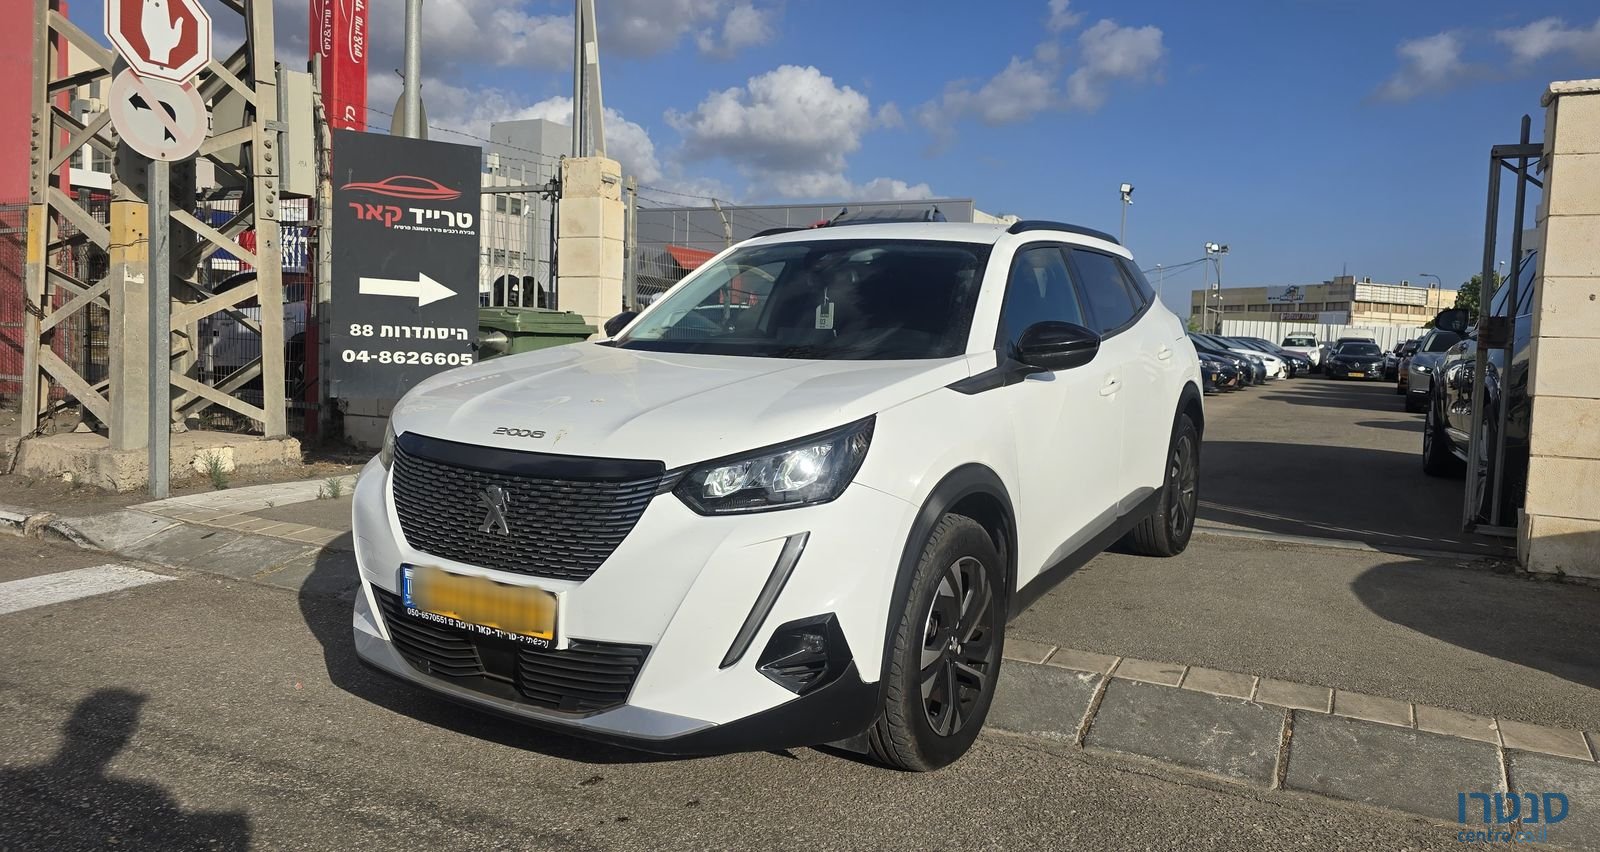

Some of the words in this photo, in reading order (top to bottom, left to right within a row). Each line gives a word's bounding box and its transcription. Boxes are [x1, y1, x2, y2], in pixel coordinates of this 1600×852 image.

[348, 202, 403, 228] קאר
[409, 207, 473, 229] טרייד
[349, 324, 374, 337] 88
[380, 325, 469, 340] היסתדרות
[342, 349, 474, 366] 04-8626605
[493, 427, 546, 439] 2008
[407, 607, 447, 624] 050-6570551
[455, 620, 475, 631] חיפה
